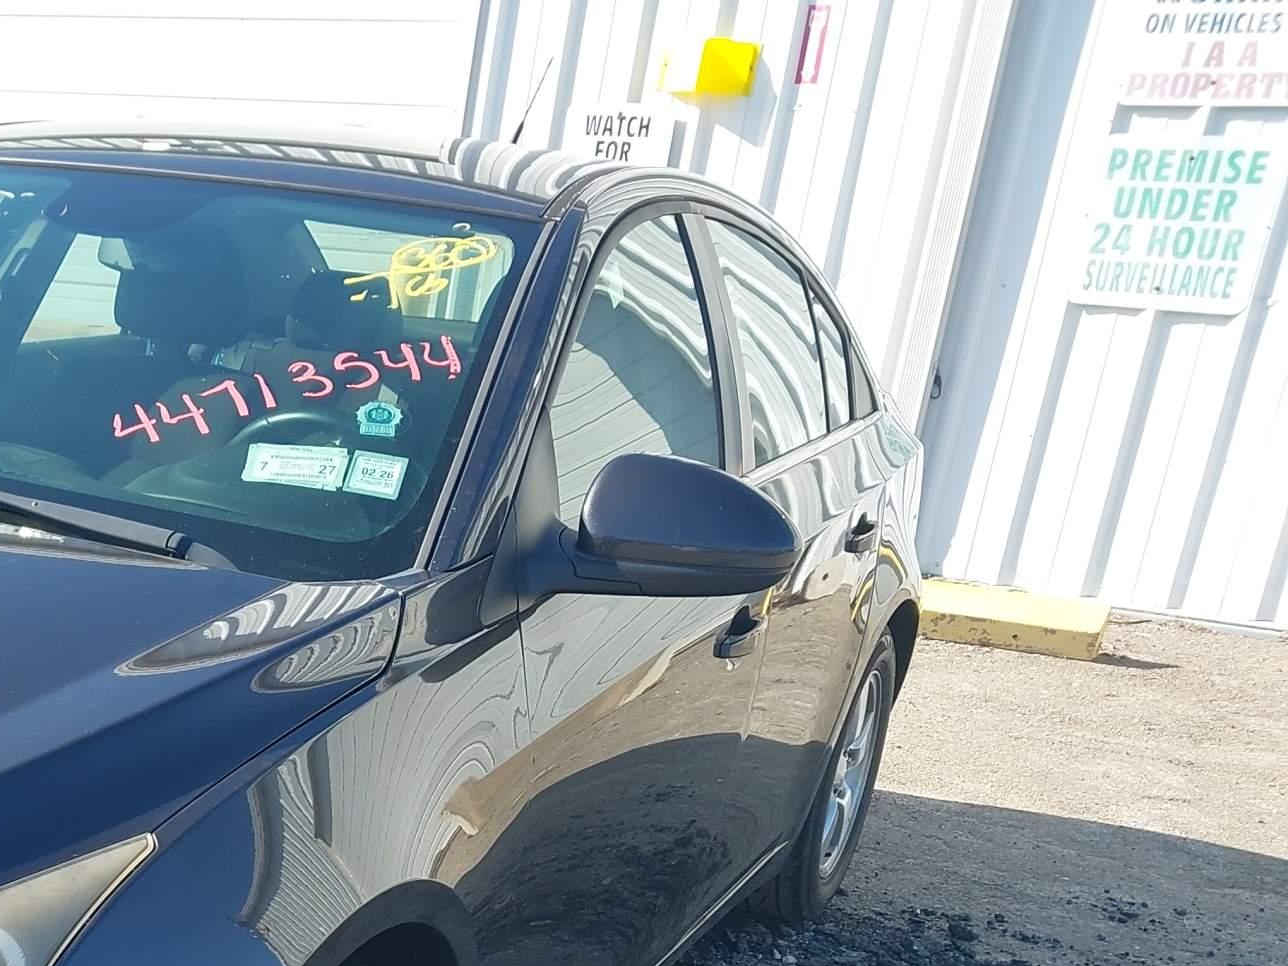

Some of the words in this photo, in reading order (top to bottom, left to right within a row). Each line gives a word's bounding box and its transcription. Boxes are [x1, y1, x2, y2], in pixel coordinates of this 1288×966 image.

[1145, 12, 1177, 34] ON
[1184, 12, 1284, 35] VEHICLES
[585, 113, 652, 138] WATCH
[594, 140, 632, 162] FOR
[1106, 148, 1271, 185] PREMISE
[1113, 186, 1238, 223] UNDER
[1089, 222, 1133, 256] 24
[1146, 226, 1246, 262] HOUR
[1082, 259, 1238, 299] SURVEILLANCE
[318, 464, 337, 475] 27
[361, 467, 377, 477] 02
[380, 470, 395, 479] 26
